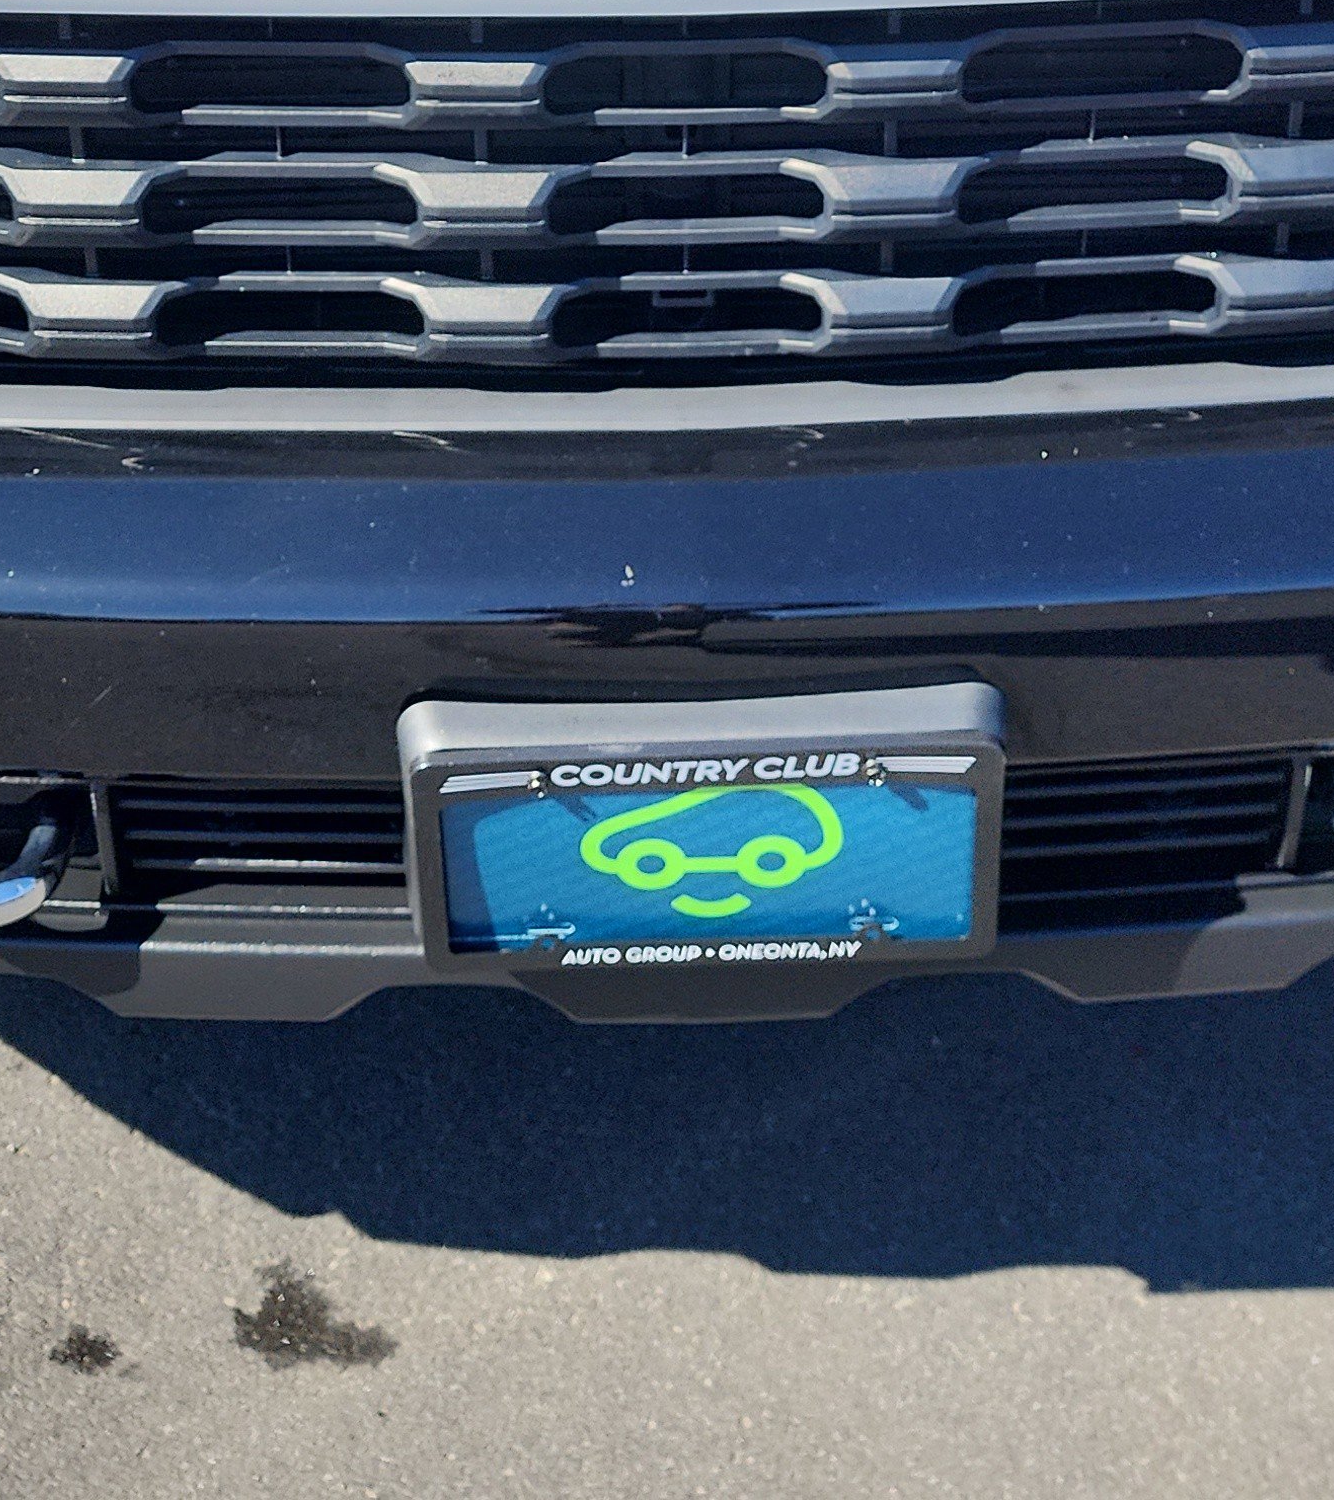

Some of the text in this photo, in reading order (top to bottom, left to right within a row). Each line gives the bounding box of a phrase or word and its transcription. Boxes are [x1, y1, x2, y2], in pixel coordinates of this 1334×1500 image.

[550, 752, 861, 787] COUNTRY CLUB
[561, 948, 622, 966] AUTO
[624, 944, 703, 964] GROUP
